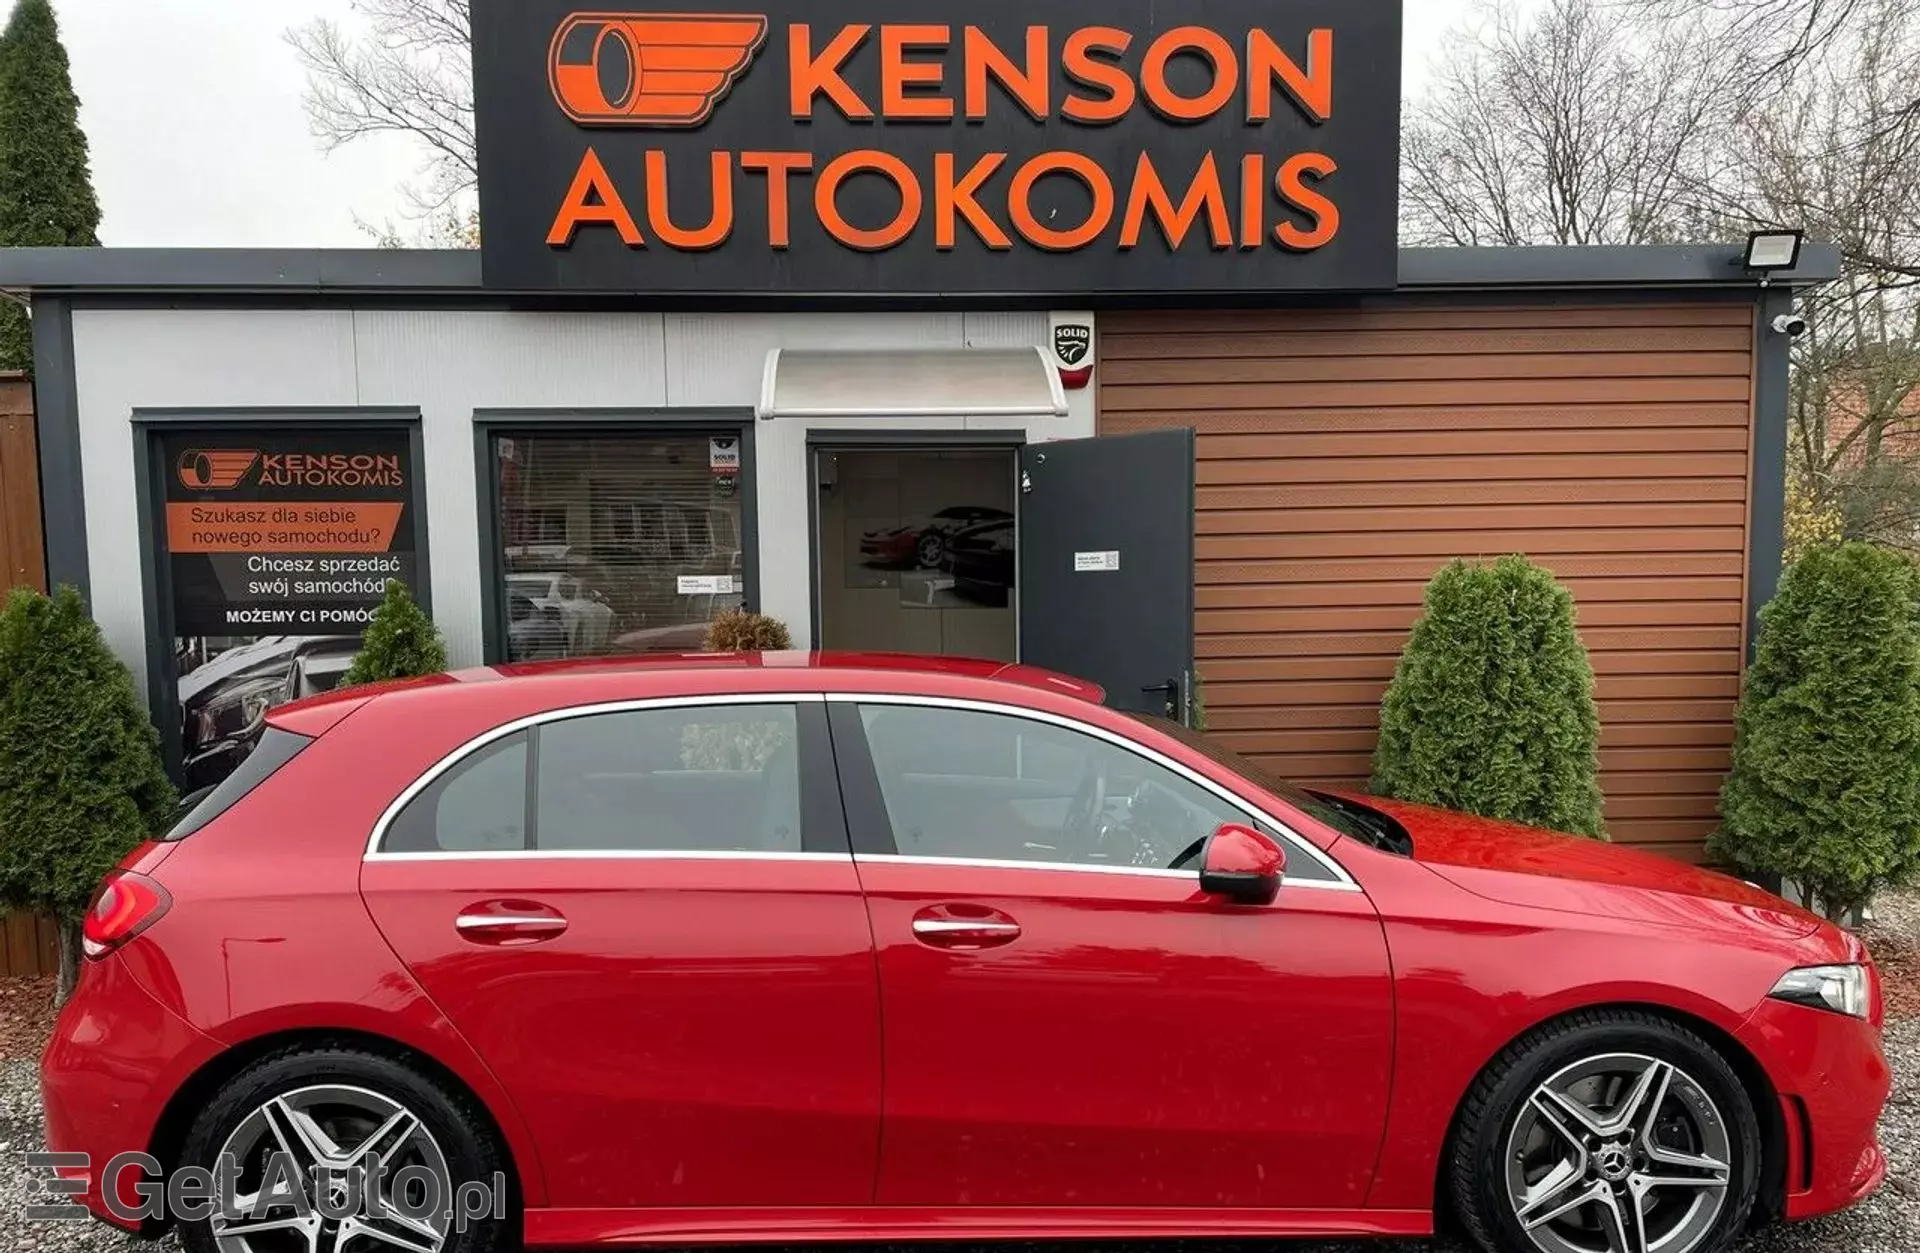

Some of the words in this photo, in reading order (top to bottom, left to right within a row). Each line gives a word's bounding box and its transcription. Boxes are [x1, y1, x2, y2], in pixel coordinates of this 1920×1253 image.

[788, 24, 1334, 125] KENSON
[545, 146, 1341, 253] AUTOKOMIS
[1056, 328, 1088, 338] SOLID
[262, 454, 399, 470] KENSON
[258, 469, 404, 486] AUTOKOMIS
[191, 507, 266, 523] Szukasz
[271, 508, 298, 523] dla
[304, 508, 356, 523] siebie
[192, 531, 262, 547] nowego
[268, 528, 381, 543] samochodu?
[247, 556, 315, 572] Chcesz
[319, 556, 400, 575] sprzedać
[248, 577, 289, 597] swój
[226, 608, 295, 623] MOŻEMY
[300, 611, 315, 622] CI
